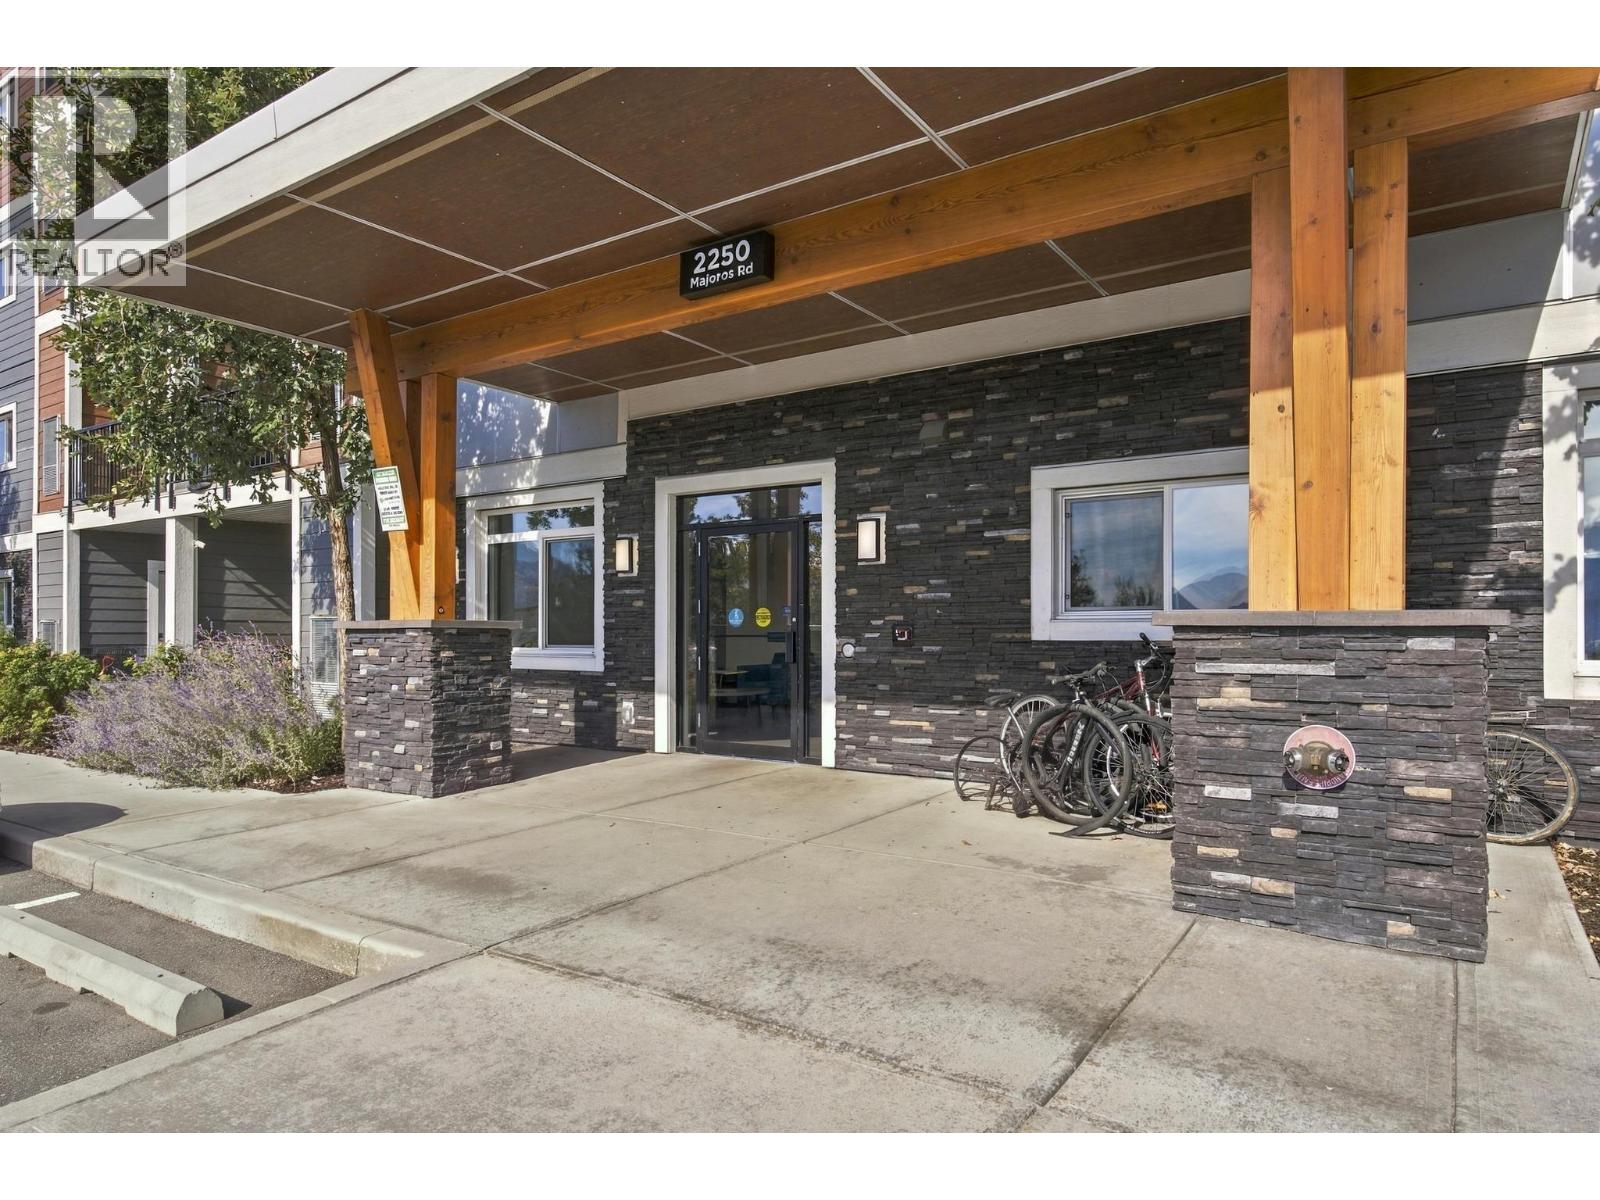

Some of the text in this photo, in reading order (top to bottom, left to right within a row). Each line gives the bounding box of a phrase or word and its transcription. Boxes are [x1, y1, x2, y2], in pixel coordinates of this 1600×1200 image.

[693, 240, 751, 274] 2250
[690, 262, 754, 289] Majoros Rd
